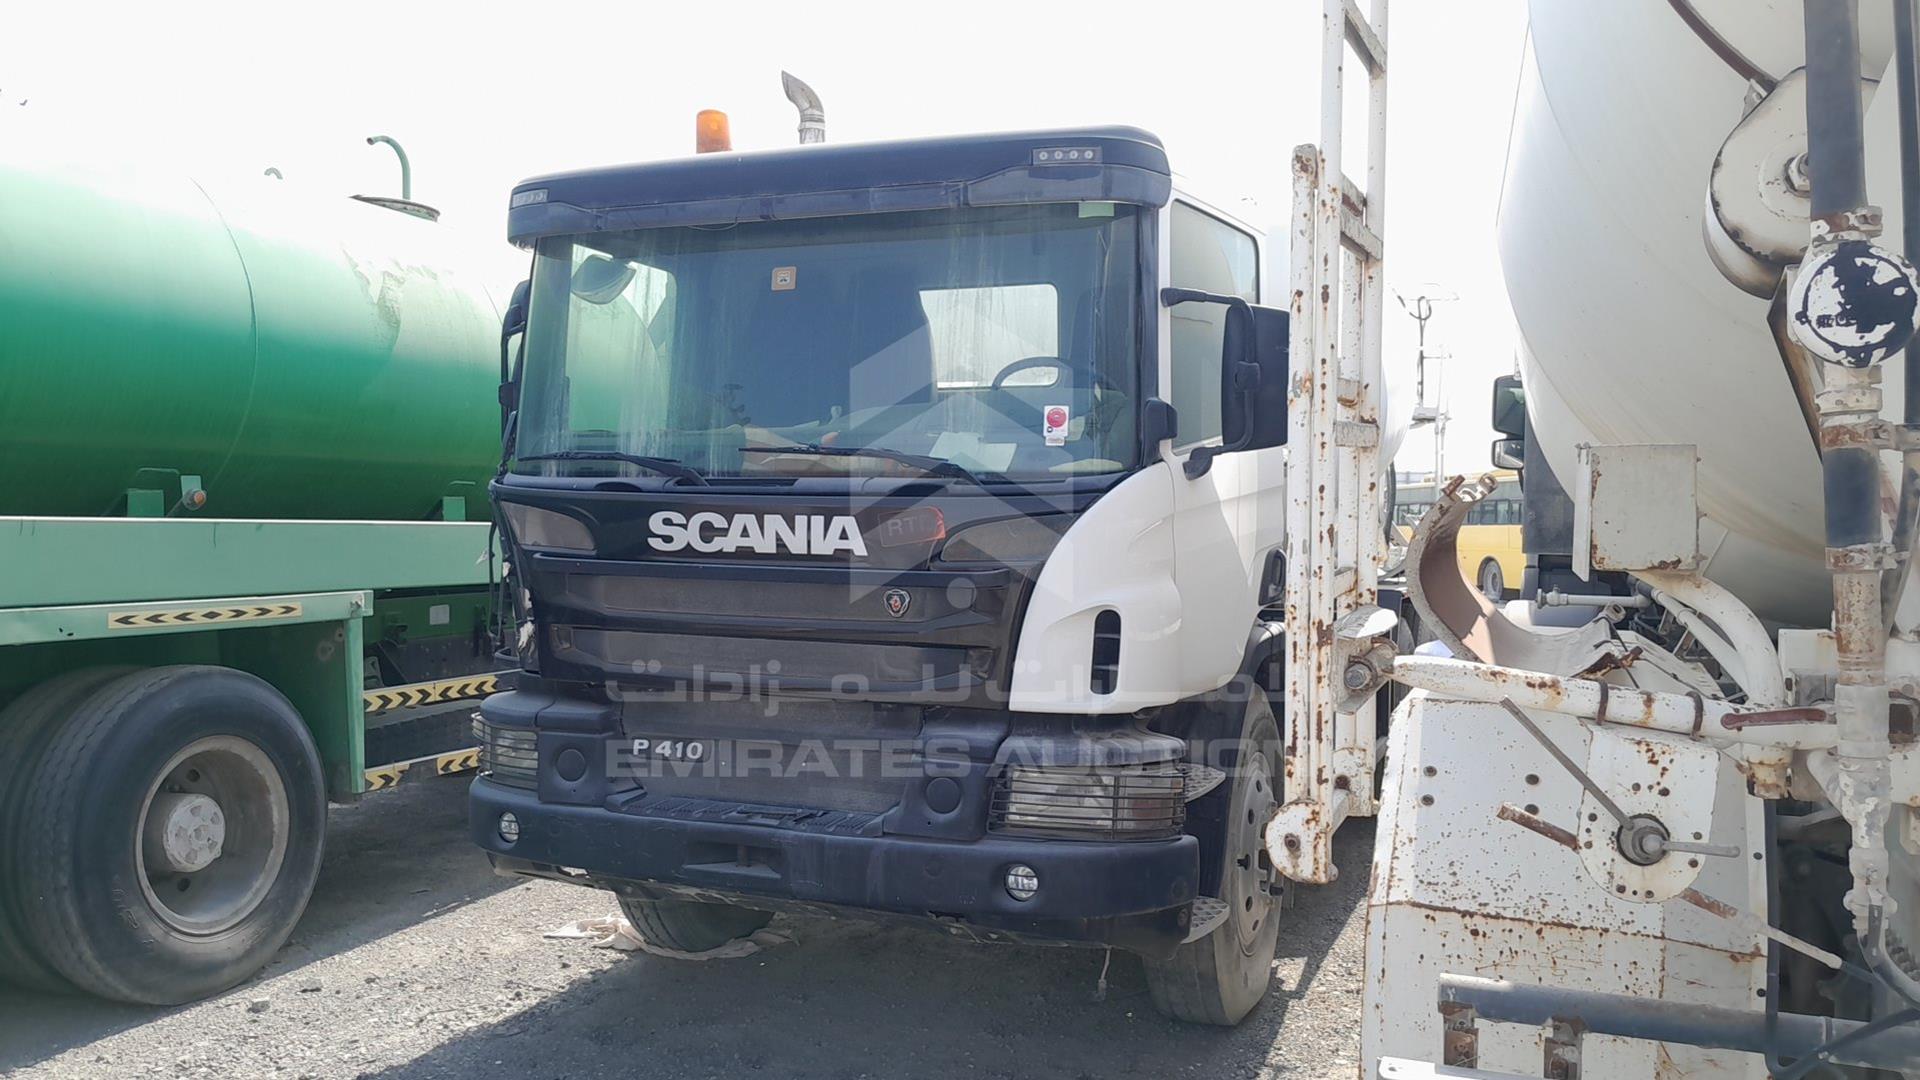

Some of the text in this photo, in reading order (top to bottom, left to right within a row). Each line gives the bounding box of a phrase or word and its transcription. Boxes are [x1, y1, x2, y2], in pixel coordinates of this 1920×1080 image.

[647, 510, 868, 556] SCANIA
[633, 739, 703, 760] P 410
